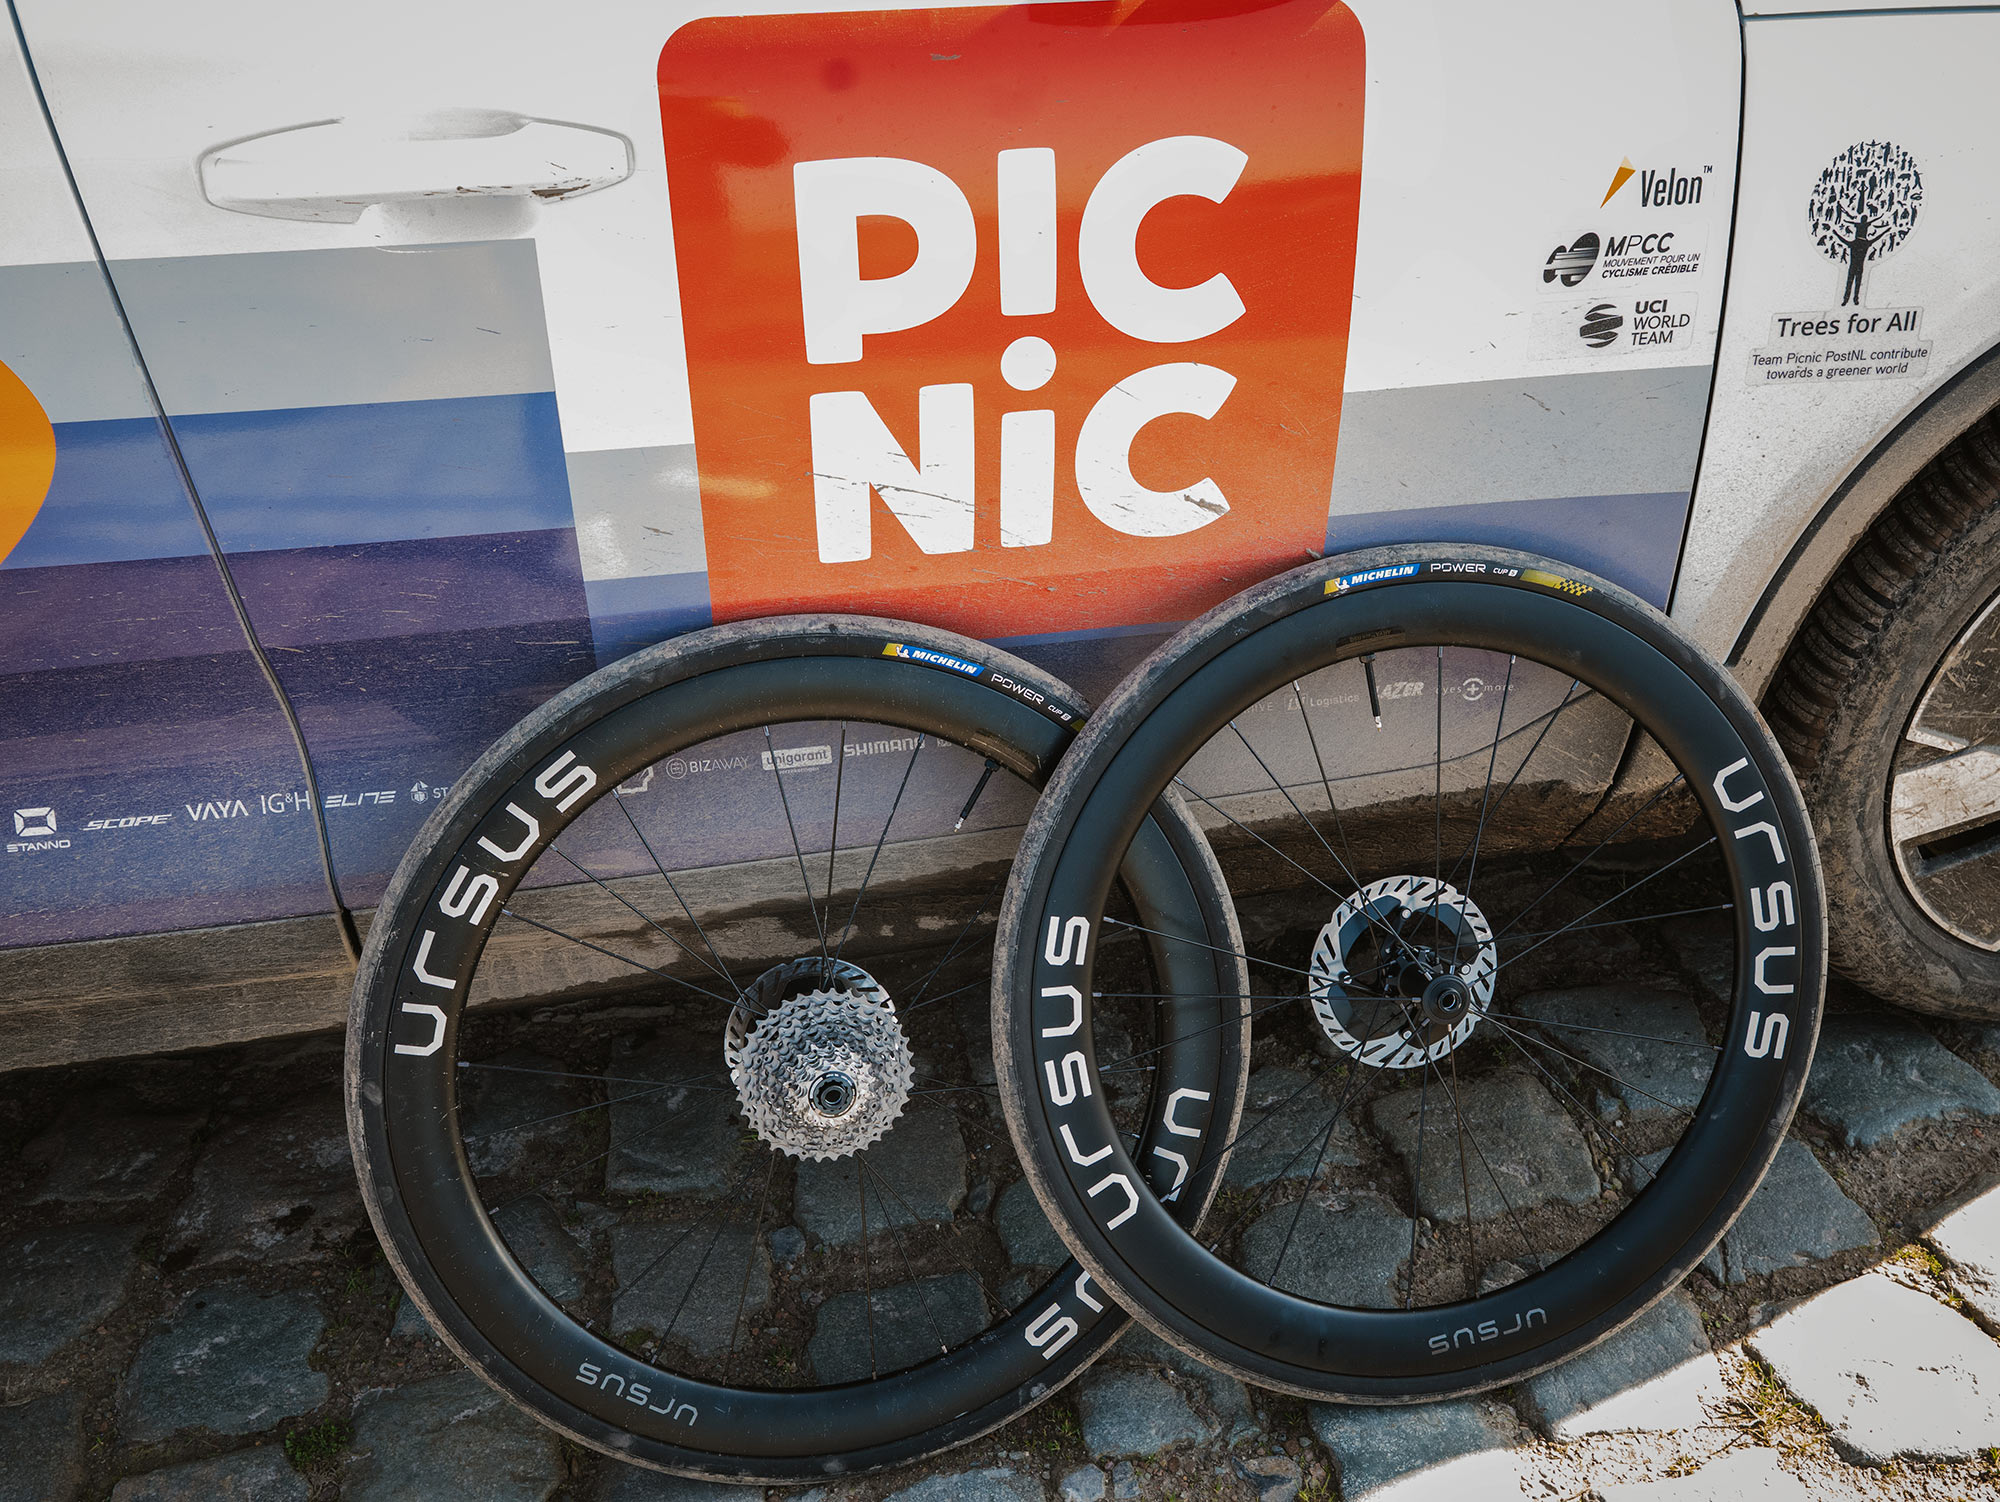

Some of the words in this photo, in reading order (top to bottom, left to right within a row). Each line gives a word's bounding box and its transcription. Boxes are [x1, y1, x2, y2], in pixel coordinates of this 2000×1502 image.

[1641, 167, 1703, 207] Velon
[1604, 232, 1675, 257] MPCC
[1602, 256, 1660, 268] MOUVEMENT
[1660, 254, 1685, 265] POUR
[1687, 252, 1701, 263] UN
[1602, 267, 1650, 279] CYCLISME
[1651, 263, 1699, 275] CRÉDIBLE
[1635, 299, 1668, 314] UCI
[1634, 314, 1690, 330] WORLD
[1778, 318, 1840, 337] Trees
[1847, 313, 1882, 334] for
[1885, 311, 1917, 333] All
[1631, 330, 1673, 346] TEAM
[1752, 353, 1783, 366] Team
[1786, 352, 1823, 365] Picnic
[1825, 349, 1866, 363] PostNL
[1870, 347, 1928, 361] contribute
[1766, 366, 1813, 380] towards
[1816, 368, 1823, 378] a
[1826, 365, 1872, 380] greener
[1875, 362, 1908, 375] world
[1351, 565, 1414, 585] MICHELIN
[1430, 562, 1487, 574] POWER
[912, 650, 978, 675] MICHELIN
[990, 673, 1045, 704] POWER
[843, 738, 926, 757] SHIMANO
[81, 812, 173, 831] SCOPE
[6, 839, 71, 853] STANNO
